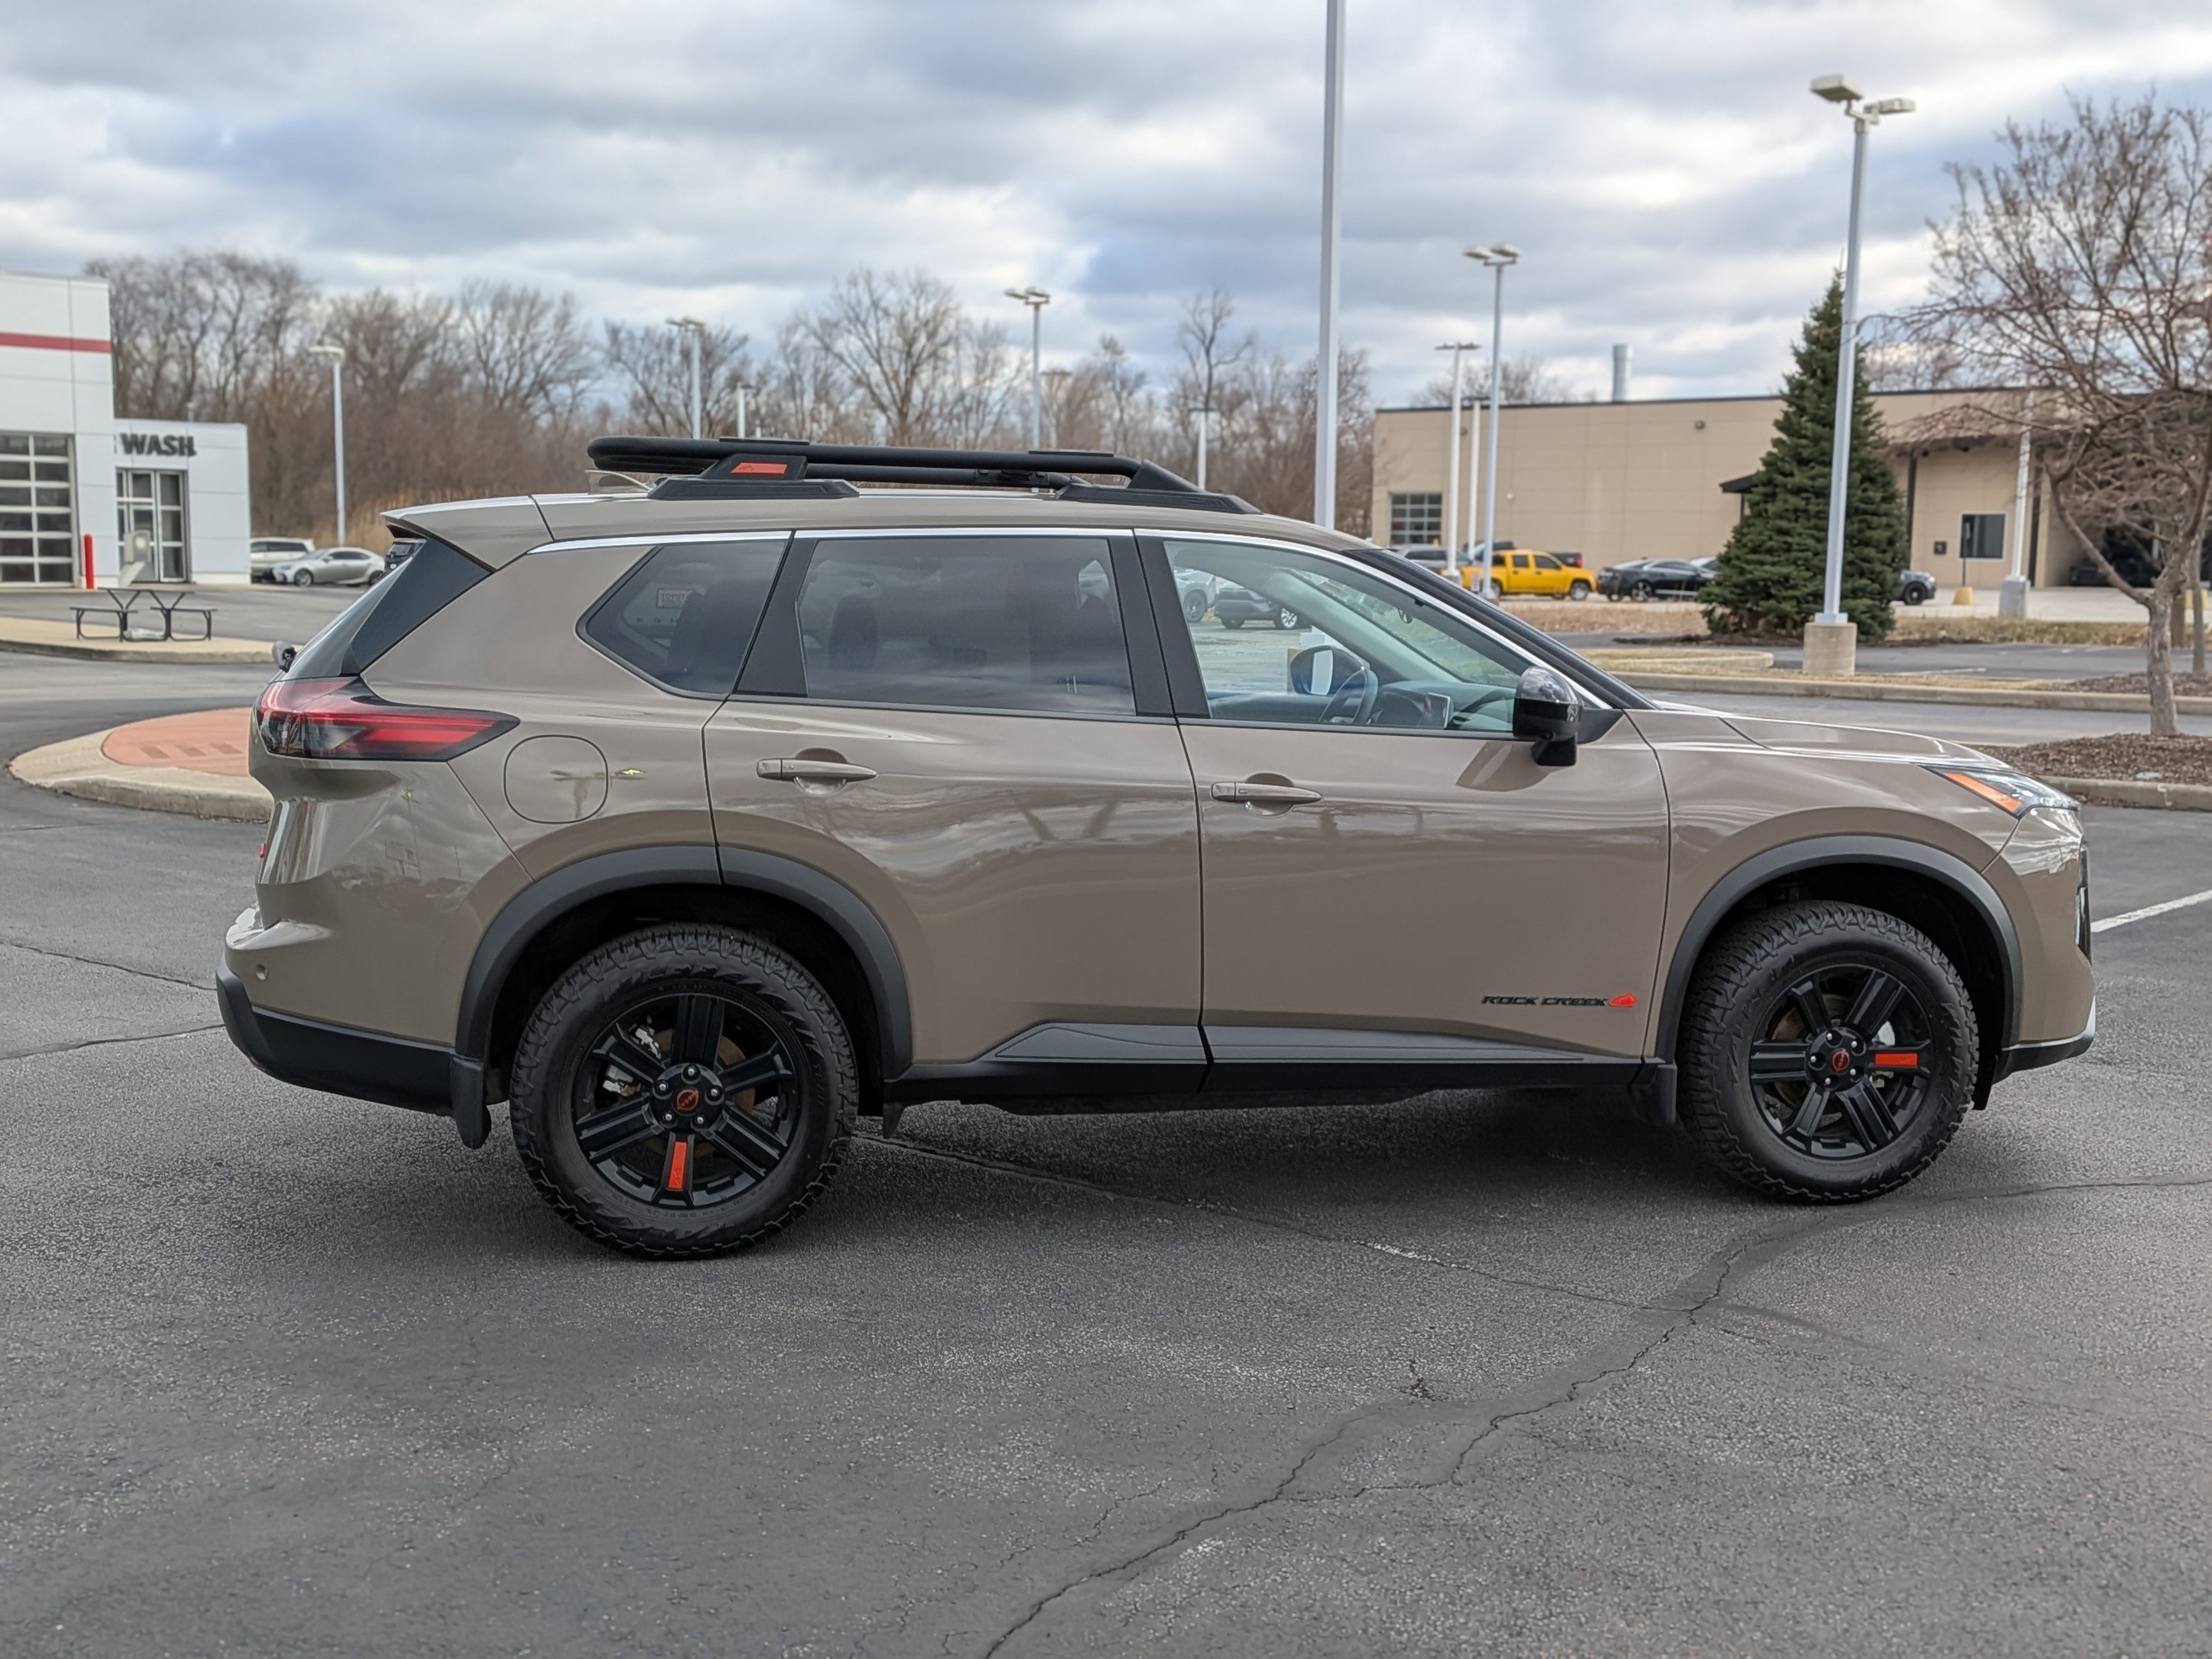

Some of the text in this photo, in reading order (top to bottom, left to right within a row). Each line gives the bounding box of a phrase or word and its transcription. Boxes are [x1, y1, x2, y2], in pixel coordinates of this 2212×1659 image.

[120, 432, 196, 456] WASH
[1481, 996, 1608, 1006] ROCK CREEK
